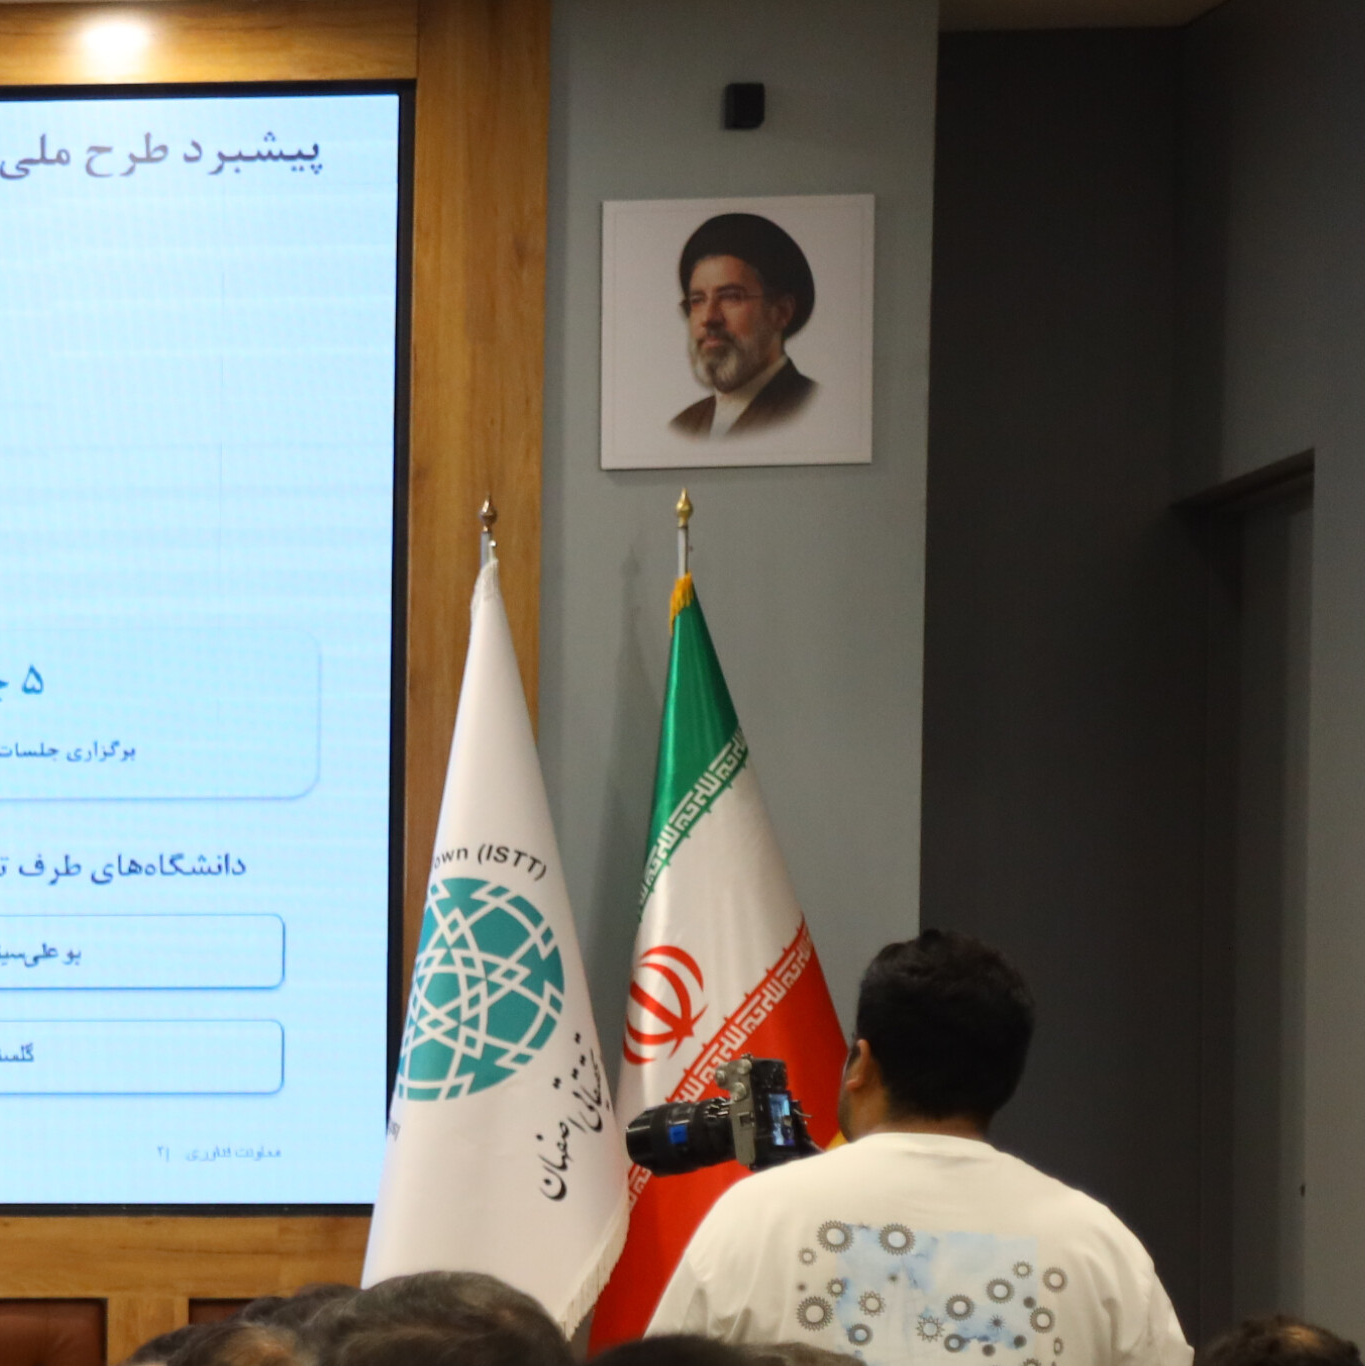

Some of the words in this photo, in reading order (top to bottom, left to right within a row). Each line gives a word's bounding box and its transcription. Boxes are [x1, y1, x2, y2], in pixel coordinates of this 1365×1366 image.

[84, 132, 169, 179] طرح
[183, 130, 324, 176] پیشبرد
[20, 664, 45, 696] ۵
[64, 738, 137, 763] برگزاری
[17, 853, 83, 887] طرف
[434, 847, 468, 869] own
[476, 844, 548, 882] (ISTT)
